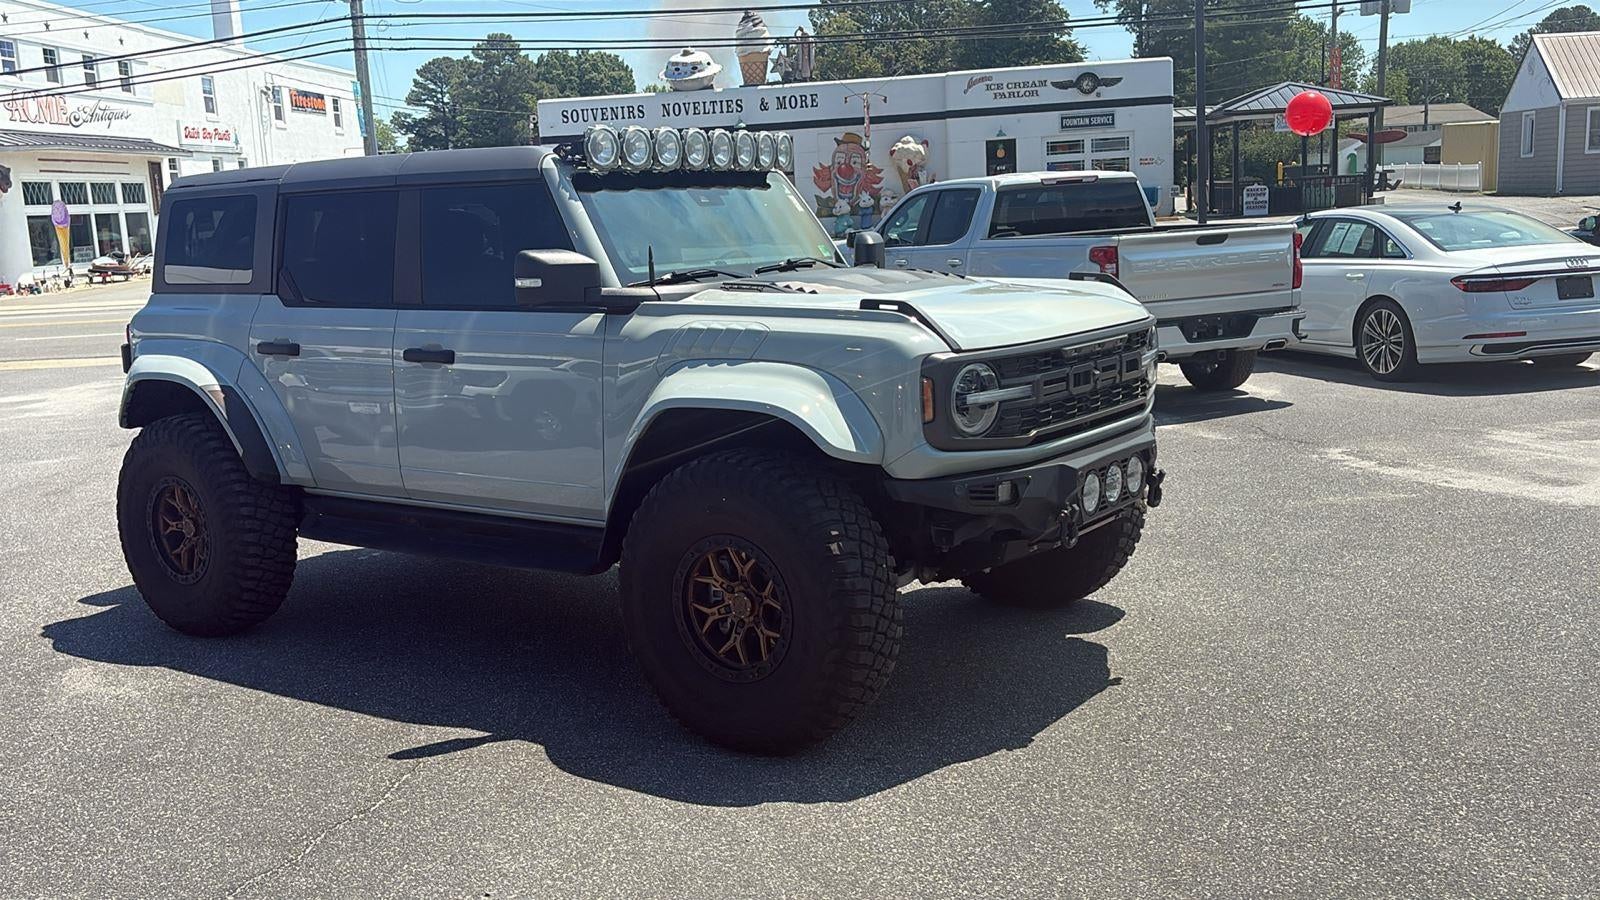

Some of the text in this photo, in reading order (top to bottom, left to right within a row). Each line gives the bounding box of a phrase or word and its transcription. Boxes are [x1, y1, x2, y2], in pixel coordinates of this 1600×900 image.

[985, 80, 1048, 92] ICE CREAM
[993, 90, 1040, 100] PARLOR
[3, 88, 132, 129] ACME Antiques
[290, 89, 326, 110] Firestone
[561, 93, 819, 124] SOUVENIRS NOVELTIES & MORE
[1062, 115, 1113, 127] FOUNTAIN SERVICE
[202, 127, 213, 143] Boy
[213, 128, 231, 141] Paints
[1037, 350, 1142, 398] FORD
